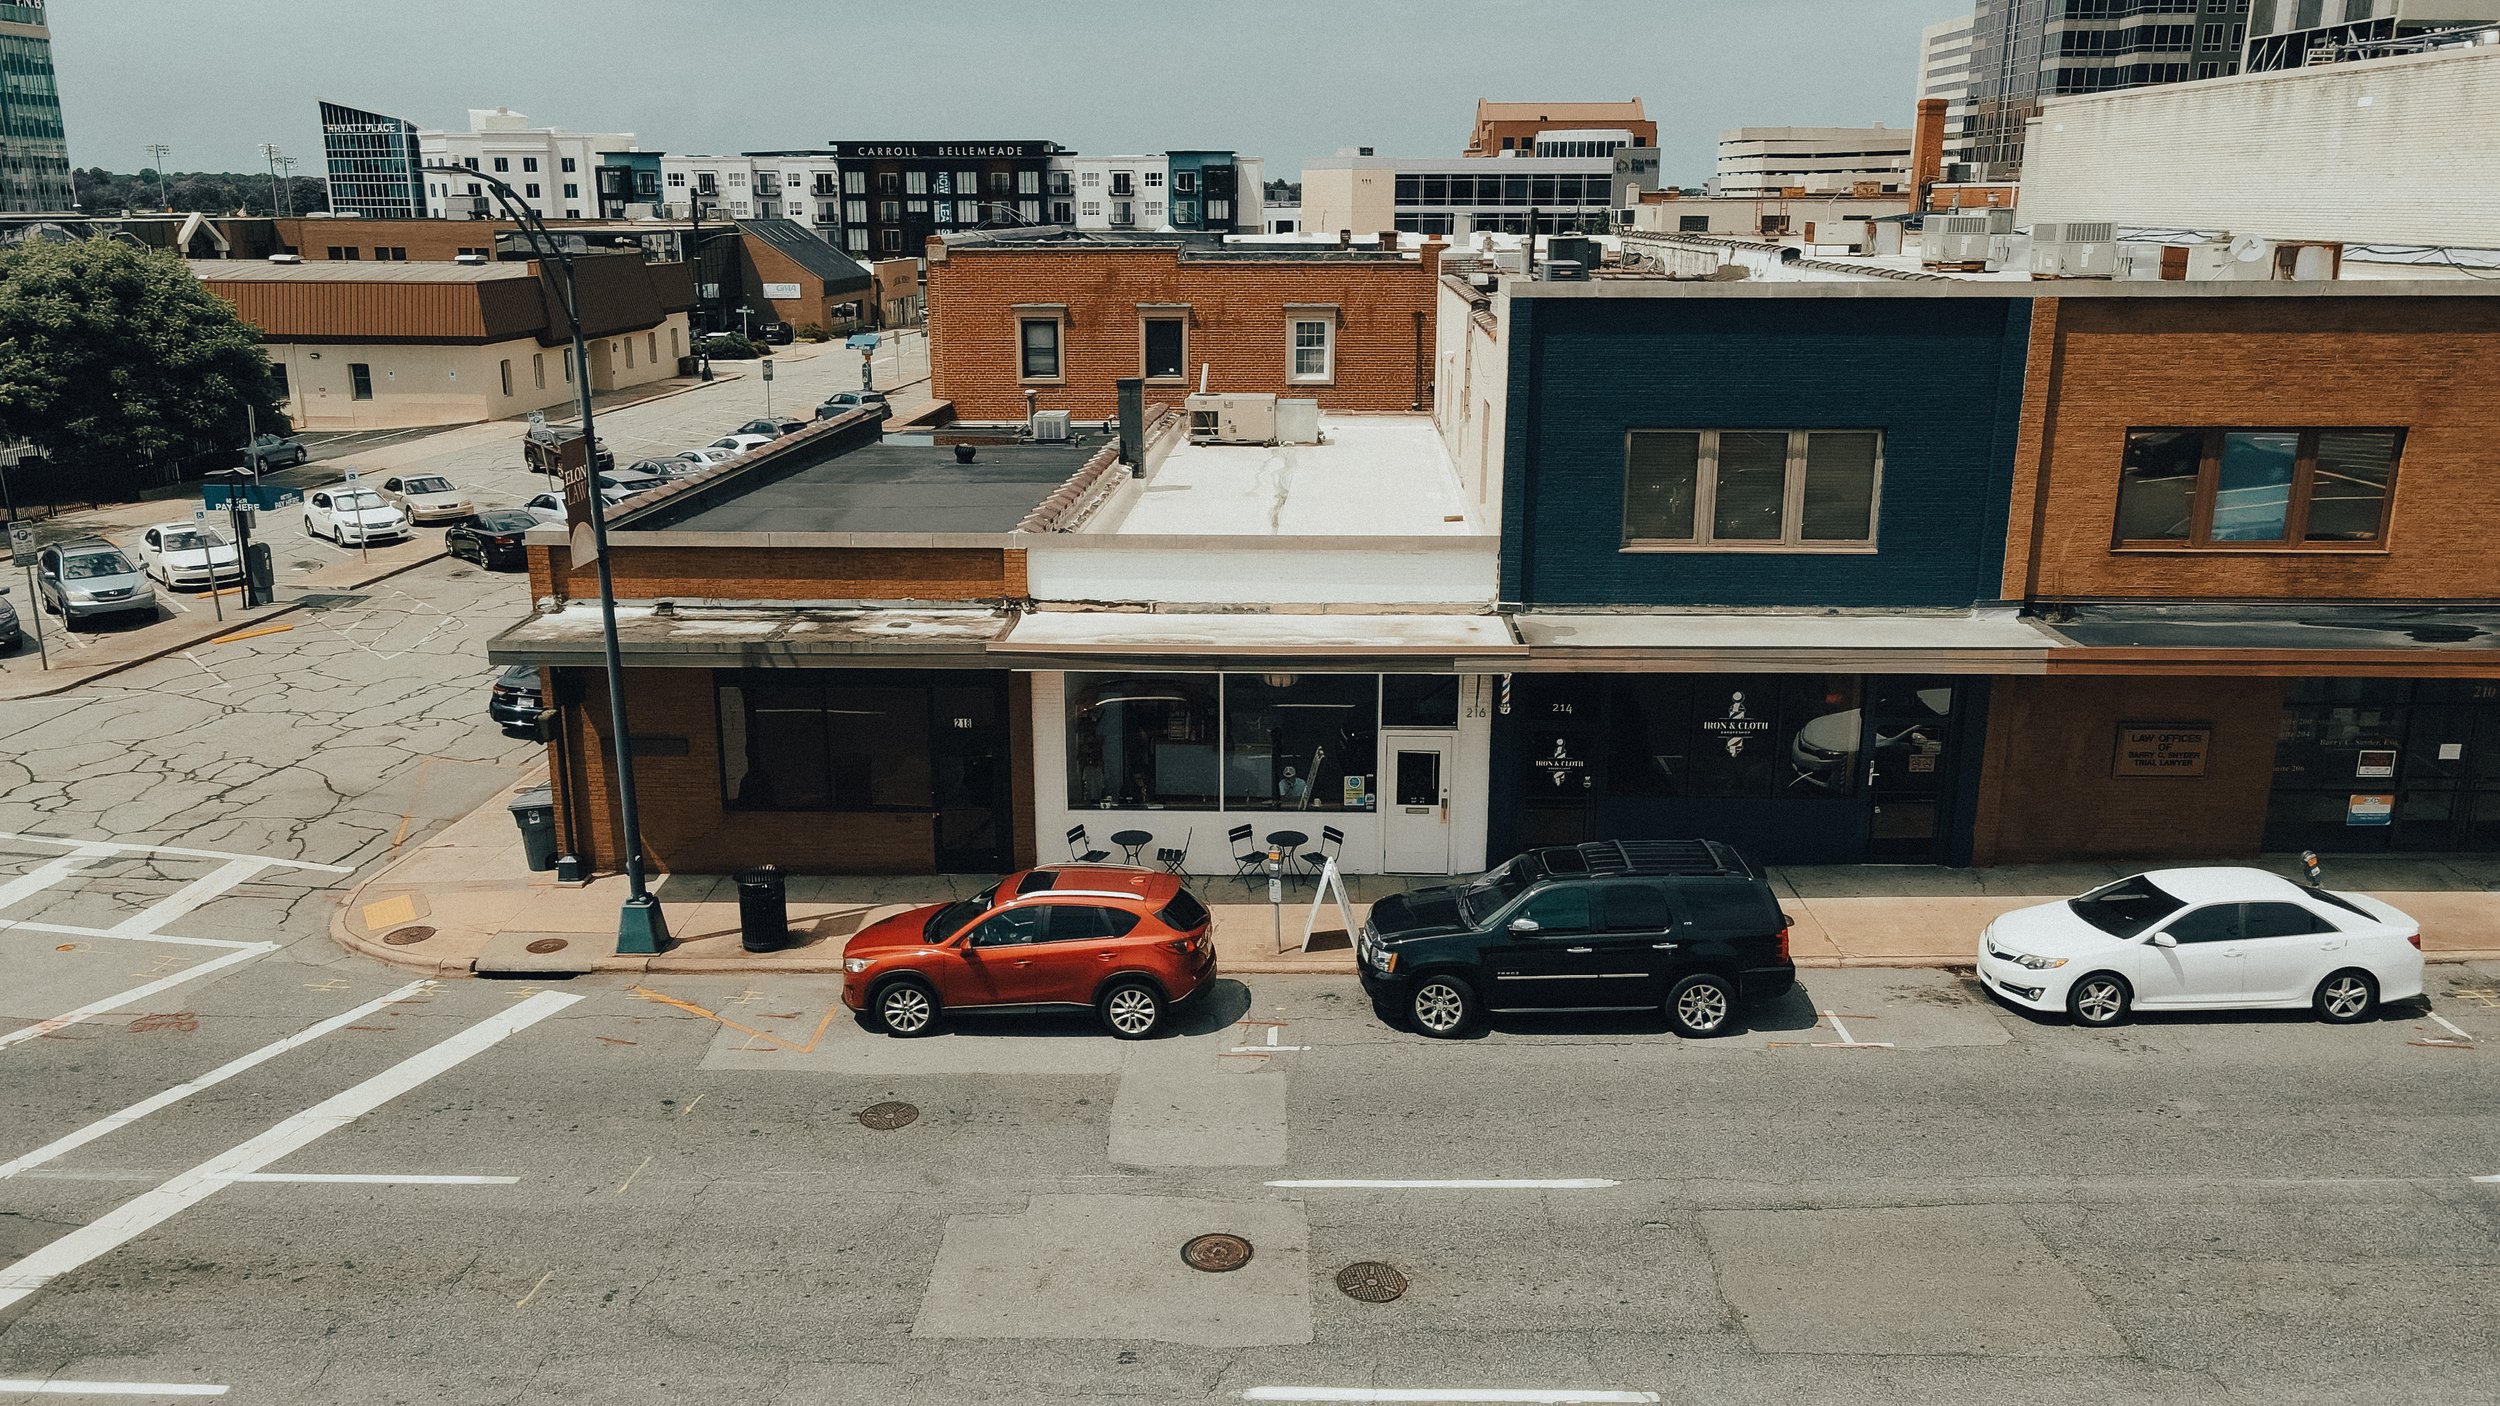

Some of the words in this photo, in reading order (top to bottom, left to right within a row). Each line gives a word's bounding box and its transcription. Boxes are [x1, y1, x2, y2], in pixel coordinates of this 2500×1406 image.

[366, 123, 396, 133] PLACE
[858, 147, 917, 156] CARROLL
[938, 146, 1023, 156] BELLEMEADE
[938, 171, 949, 194] NOW
[565, 464, 587, 486] ELON
[566, 480, 588, 506] LAW
[1466, 707, 1487, 718] 216
[1552, 703, 1573, 715] 214
[953, 718, 972, 729] 218
[1703, 721, 1727, 730] IRON
[1729, 721, 1737, 730] &
[1738, 721, 1769, 730] CLOTH
[2131, 734, 2155, 743] LAW
[2158, 734, 2202, 743] OFFICES
[2158, 743, 2173, 752] OF
[2128, 751, 2154, 759] BARRY
[2168, 751, 2200, 759] SNYDER
[2134, 759, 2157, 767] TRIAL
[2159, 759, 2193, 767] LAWYER
